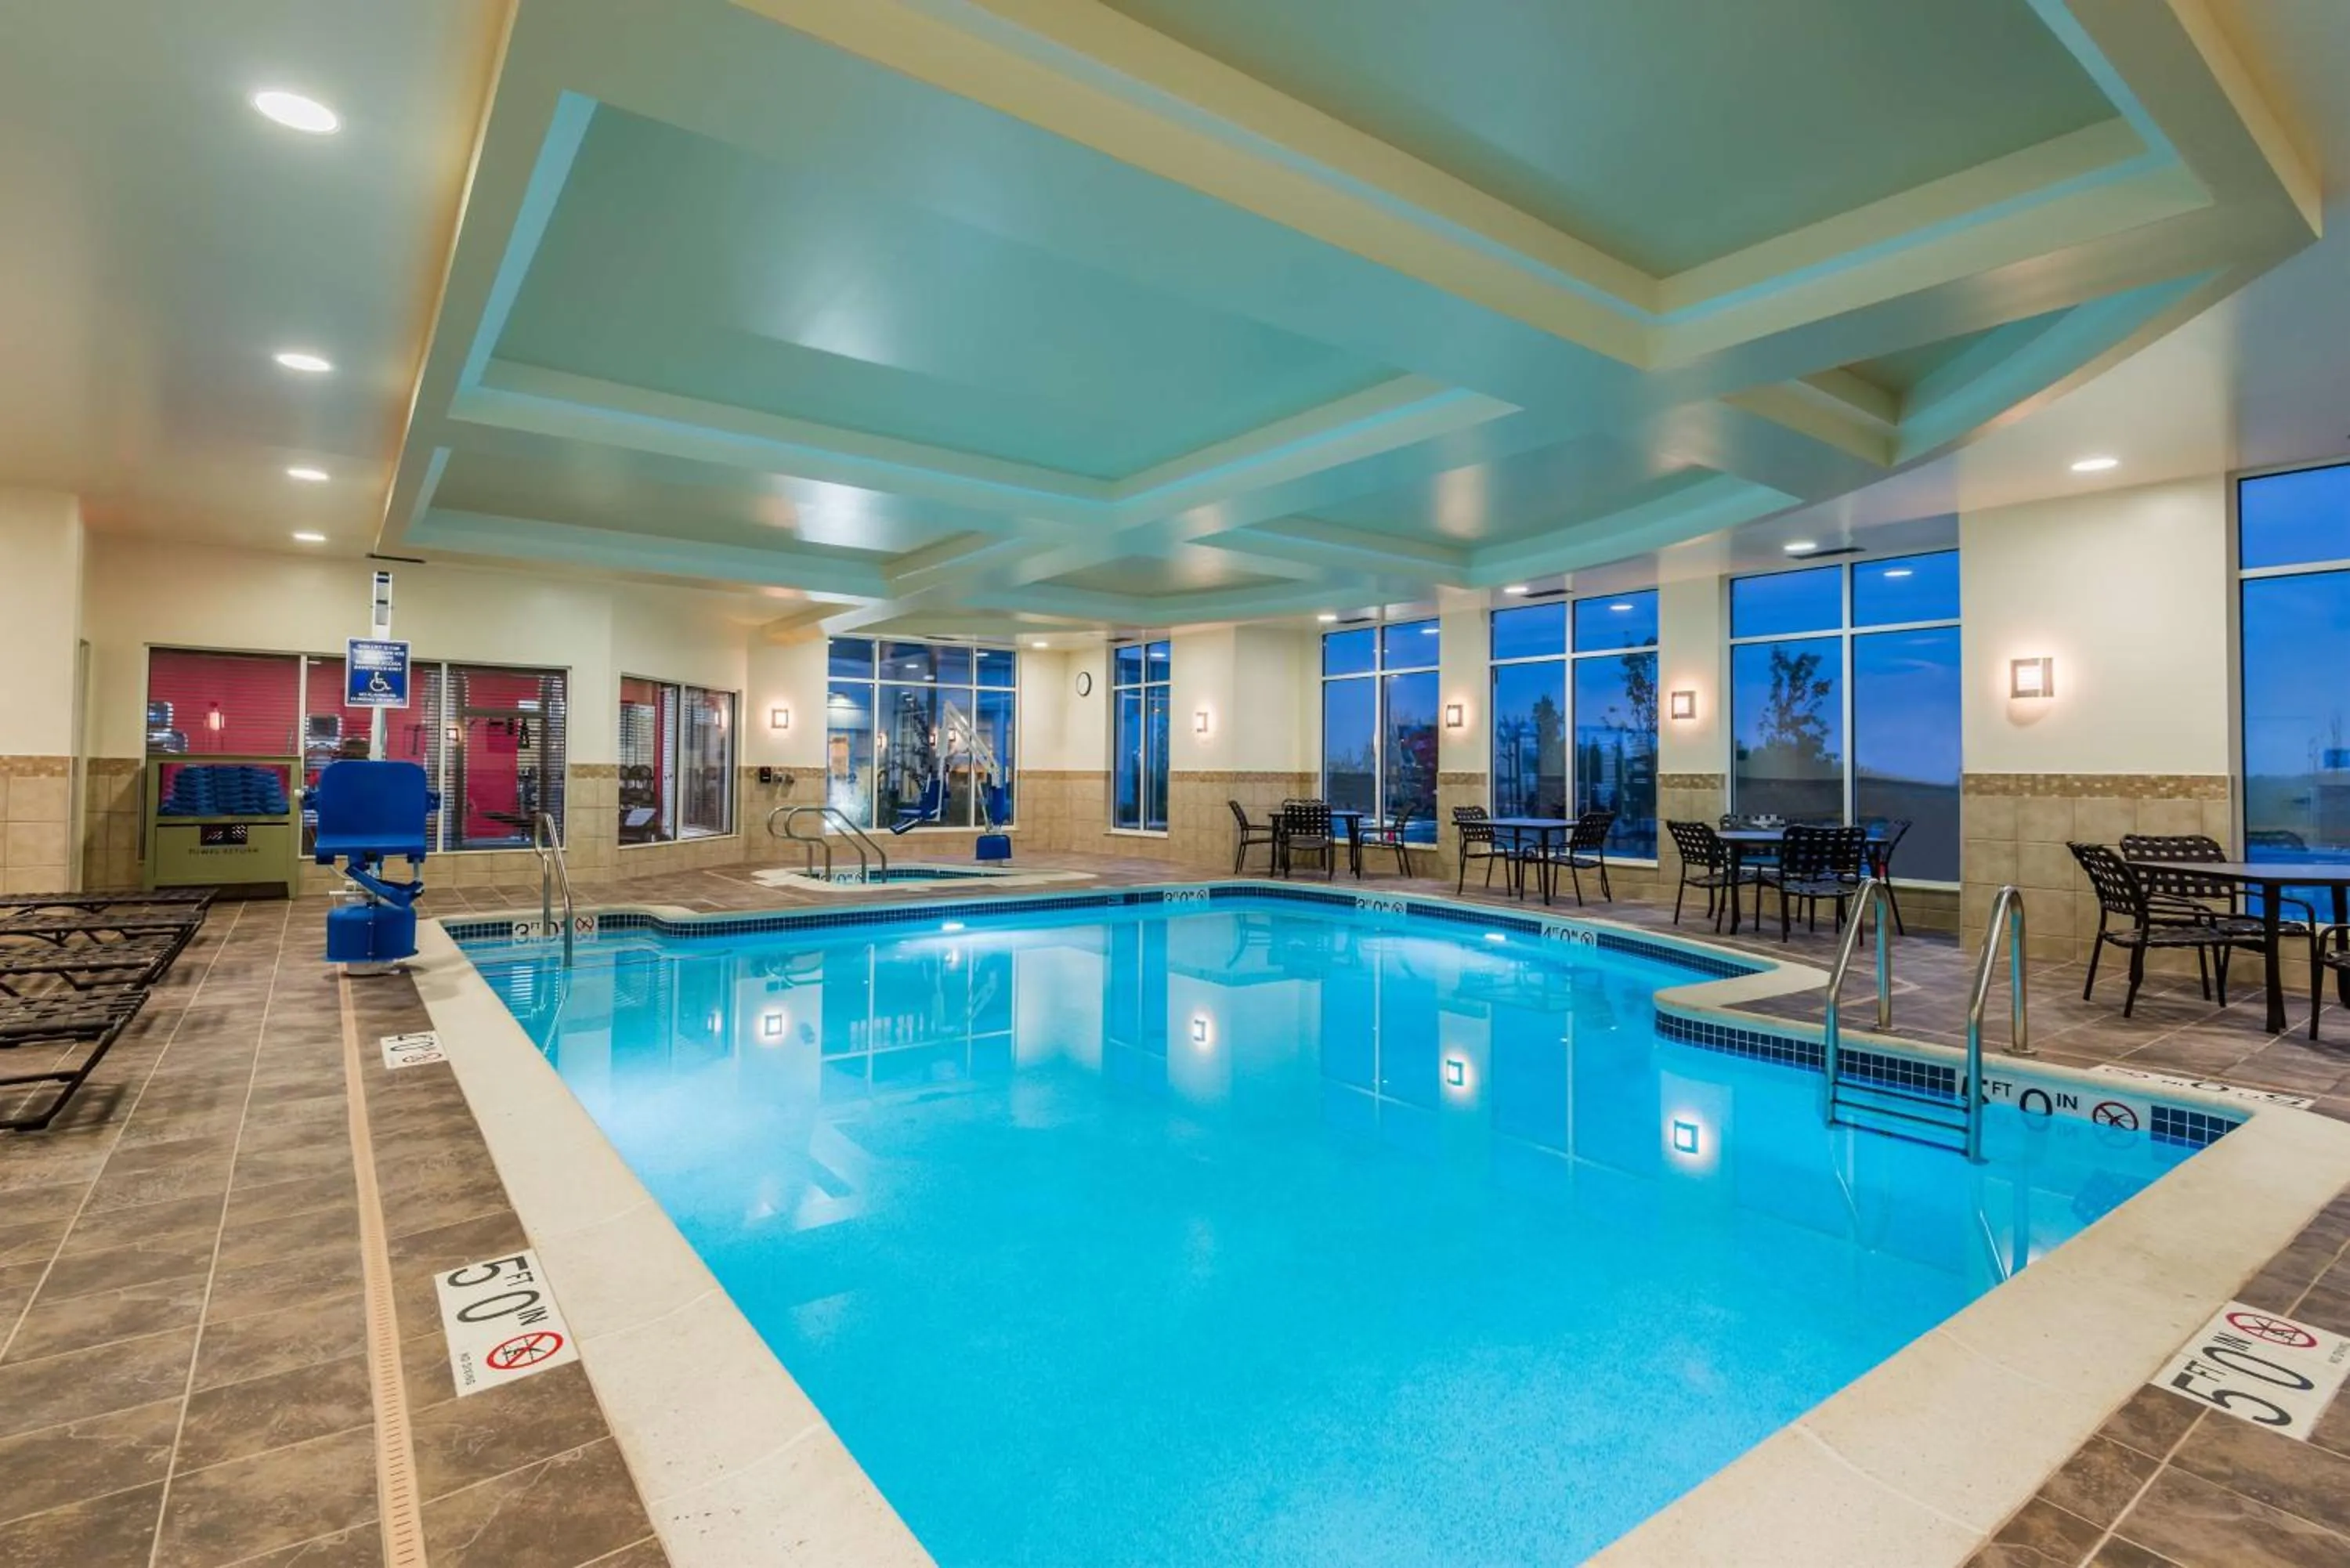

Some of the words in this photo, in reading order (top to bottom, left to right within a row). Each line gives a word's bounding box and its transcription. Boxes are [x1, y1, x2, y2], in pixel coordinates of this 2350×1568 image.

[1992, 1081, 2012, 1097] FT
[2056, 1092, 2078, 1111] IN
[447, 1255, 529, 1287] 5
[504, 1270, 534, 1287] FT
[457, 1290, 540, 1323] 0
[517, 1306, 549, 1327] IN
[2184, 1360, 2227, 1382] FT
[2203, 1346, 2315, 1390] 0
[2171, 1371, 2292, 1425] 5
